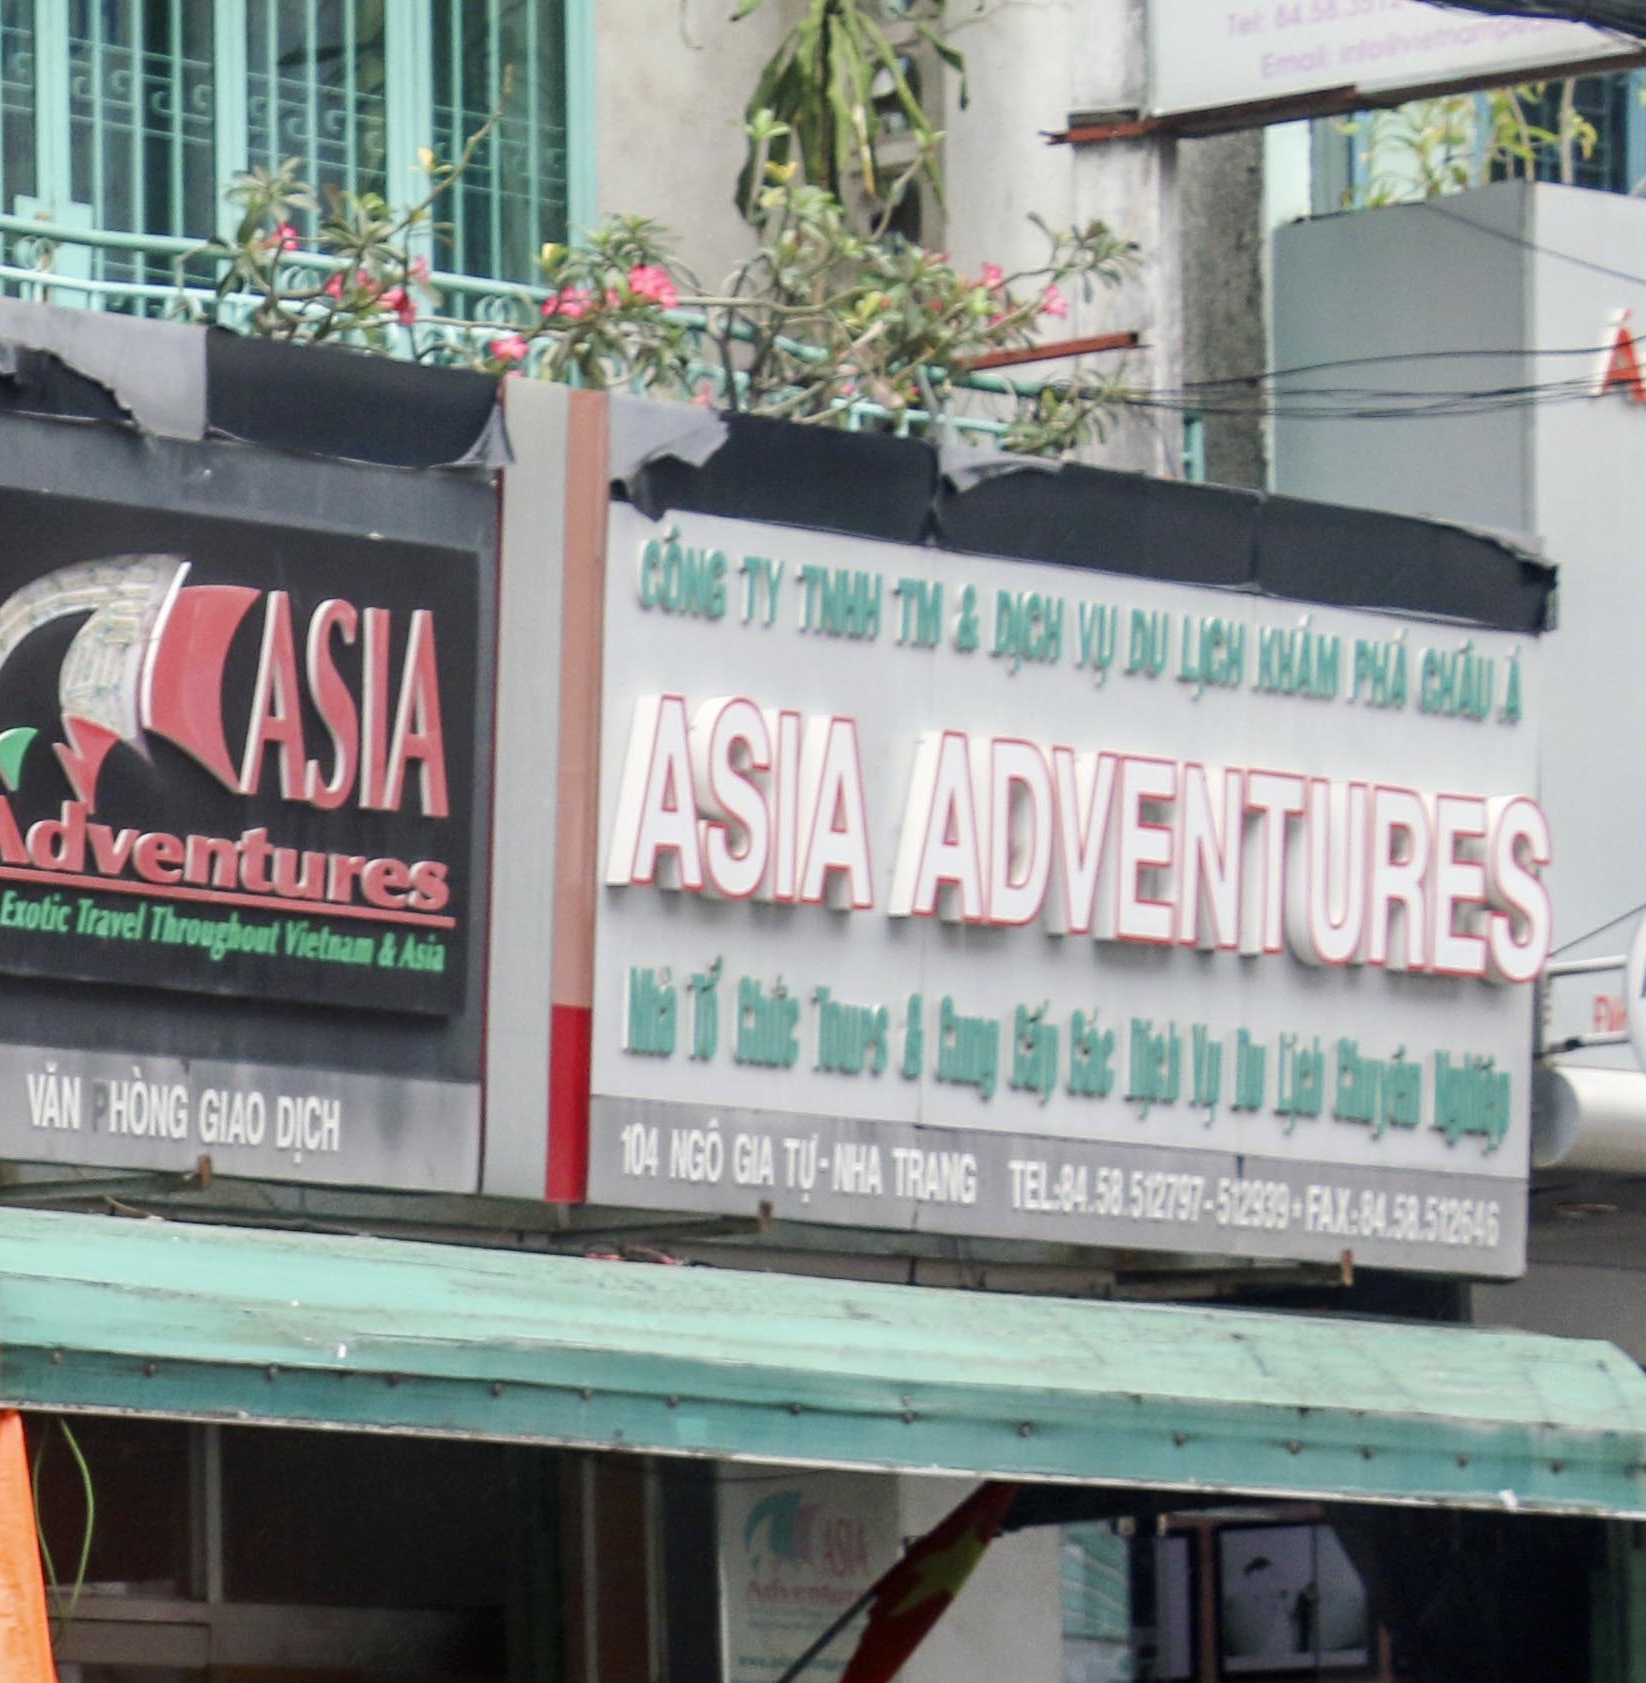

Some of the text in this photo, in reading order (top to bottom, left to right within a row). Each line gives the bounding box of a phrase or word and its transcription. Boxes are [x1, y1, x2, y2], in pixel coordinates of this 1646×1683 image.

[740, 554, 785, 628] TY
[796, 563, 883, 642] TNHH
[894, 576, 944, 649] TM
[1125, 606, 1170, 680] DU
[1349, 626, 1410, 711] PHÁ
[240, 589, 450, 819] ASIA
[608, 693, 1554, 983] ASIA ADVENTURES
[76, 899, 146, 941] Travel
[149, 907, 283, 964] Throughout
[283, 923, 375, 967] Vietnam
[399, 936, 446, 974] Asia
[26, 1061, 82, 1131] VĂN
[197, 1087, 267, 1146] GIAO
[274, 1094, 342, 1166] DỊCH
[620, 1122, 660, 1178] 104
[669, 1116, 724, 1184] NGÔ
[733, 1132, 775, 1187] GIA
[892, 1146, 978, 1206] TRANG
